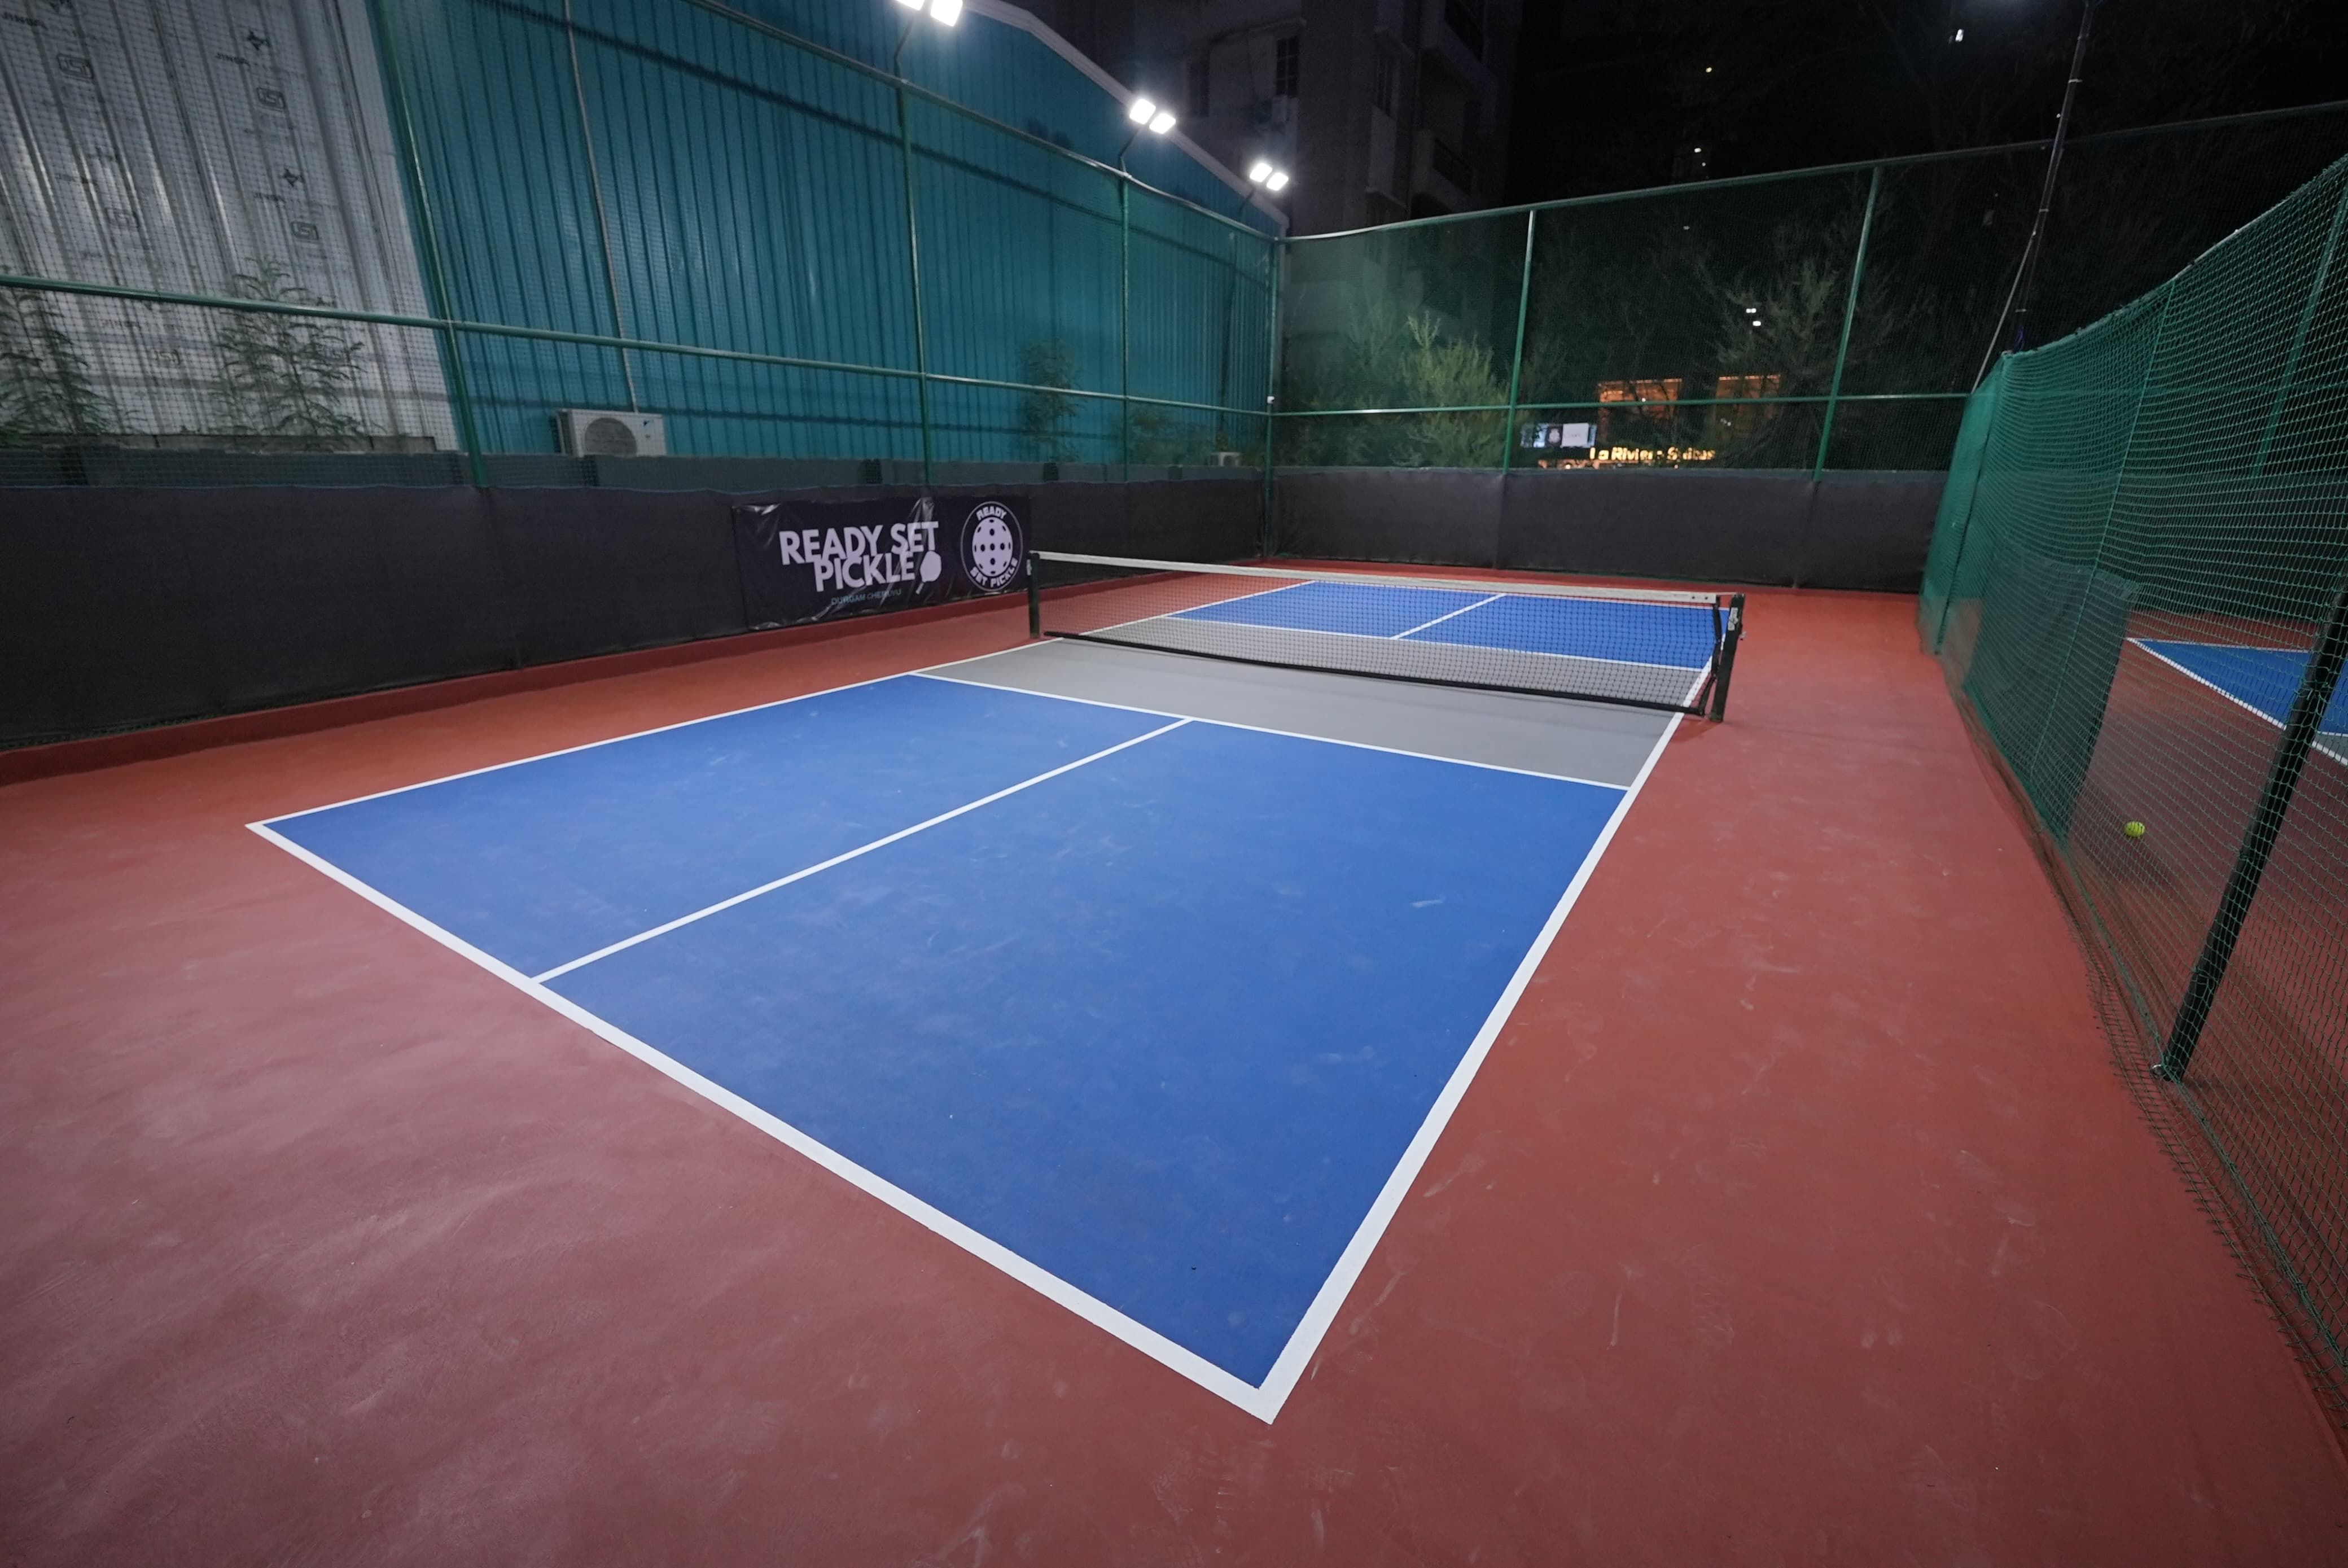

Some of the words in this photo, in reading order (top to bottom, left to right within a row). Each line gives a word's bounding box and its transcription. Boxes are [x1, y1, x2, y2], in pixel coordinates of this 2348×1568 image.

[976, 506, 1007, 521] READY
[779, 524, 883, 566] READY
[890, 521, 939, 555] SET
[812, 550, 915, 593] PICKLE
[970, 566, 988, 586] SET
[990, 557, 1019, 588] PICKLE
